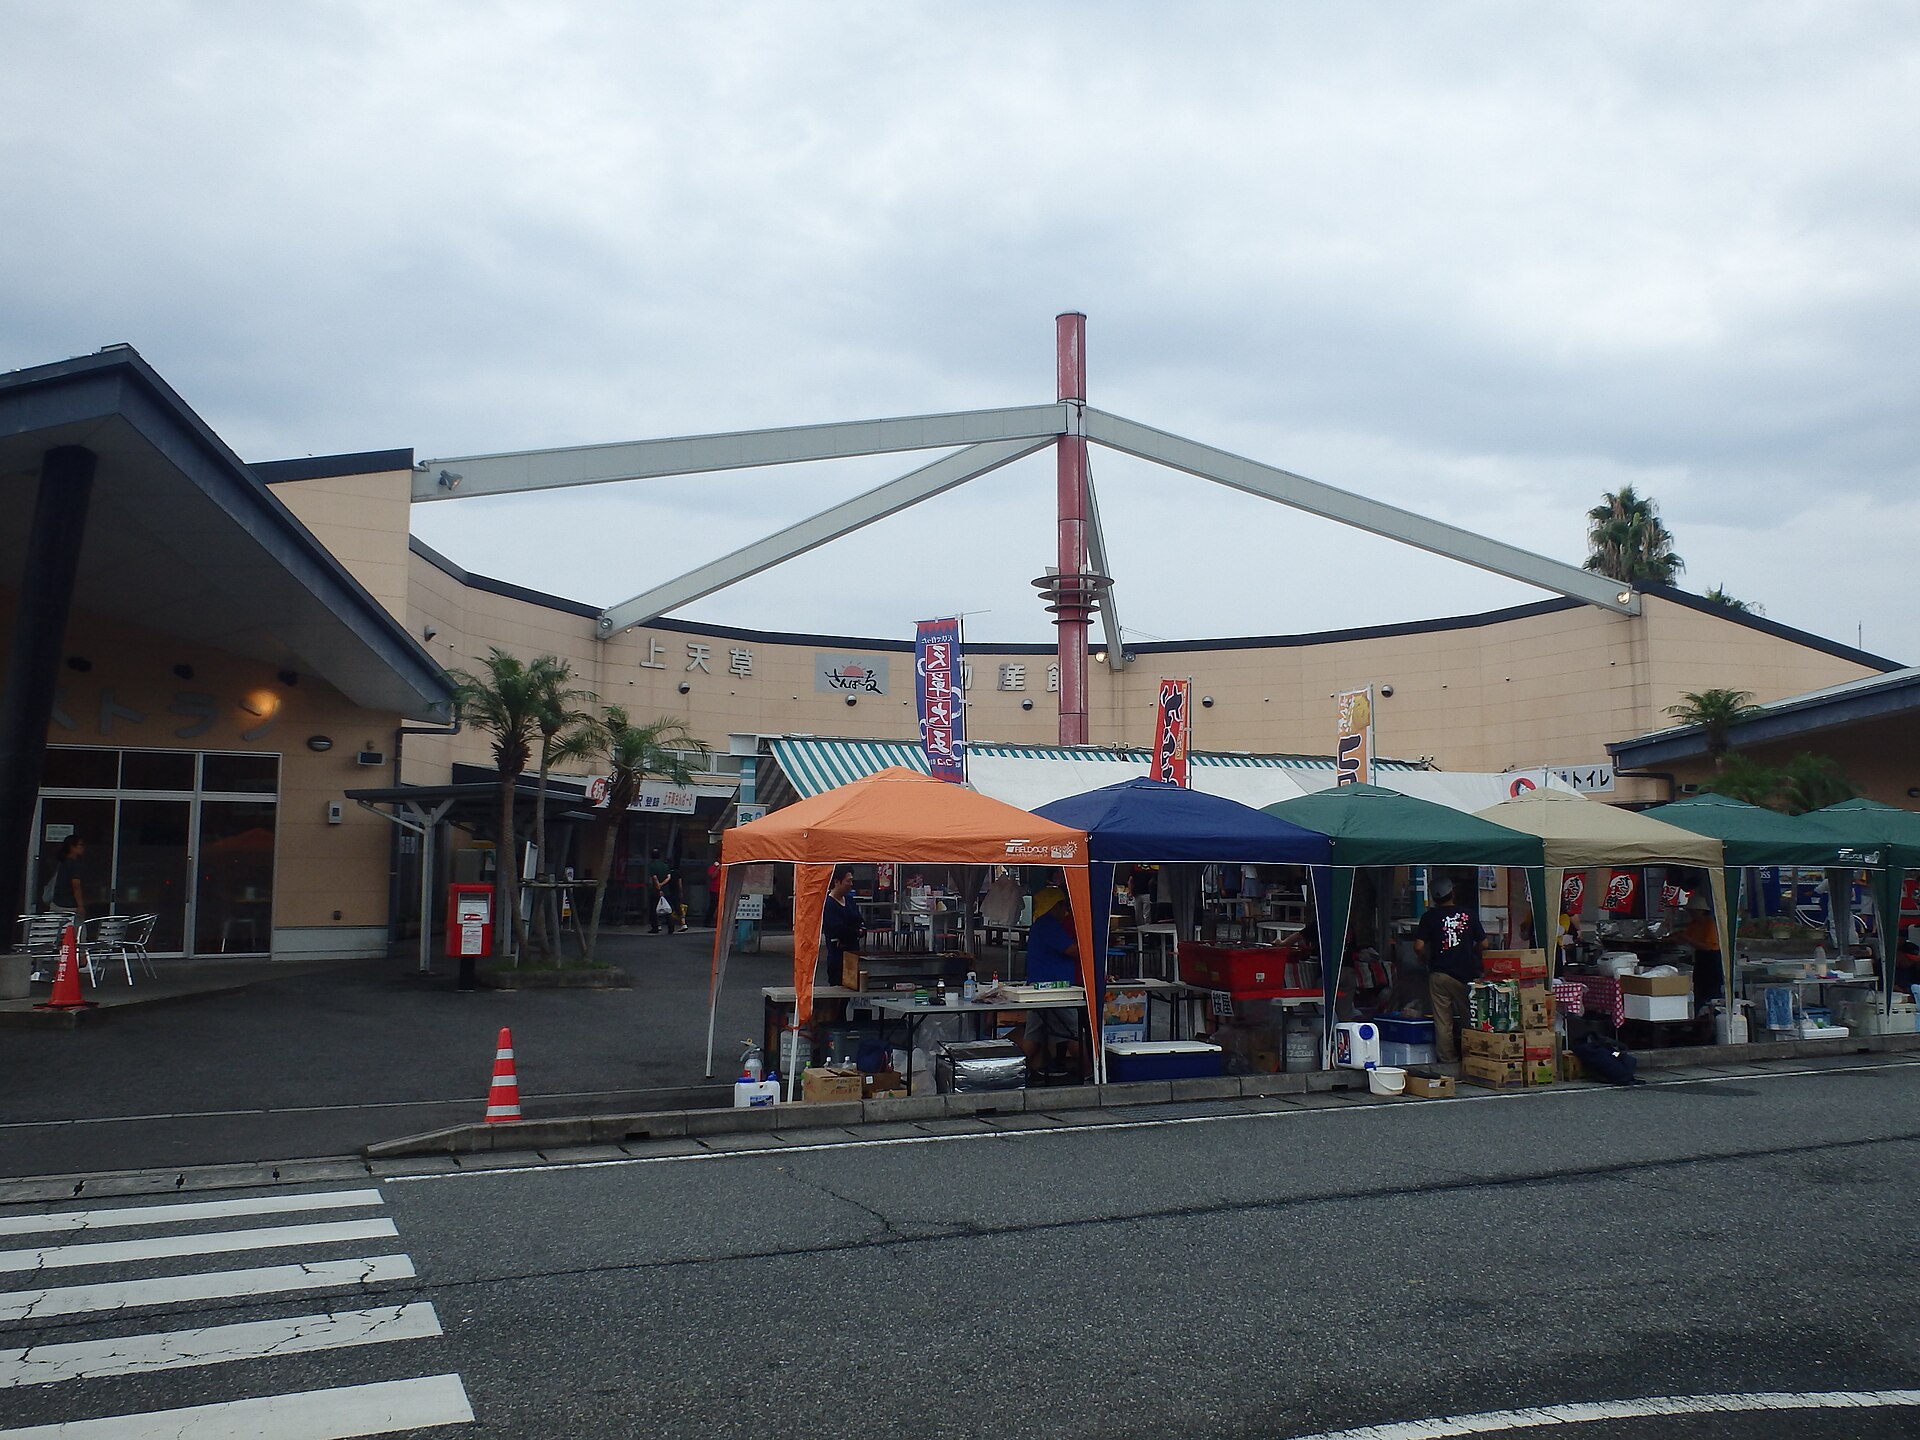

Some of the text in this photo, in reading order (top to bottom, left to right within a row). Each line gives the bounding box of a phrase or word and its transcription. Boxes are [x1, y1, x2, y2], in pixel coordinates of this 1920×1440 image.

[640, 637, 753, 679] 上天草
[1572, 769, 1610, 789] トイレ
